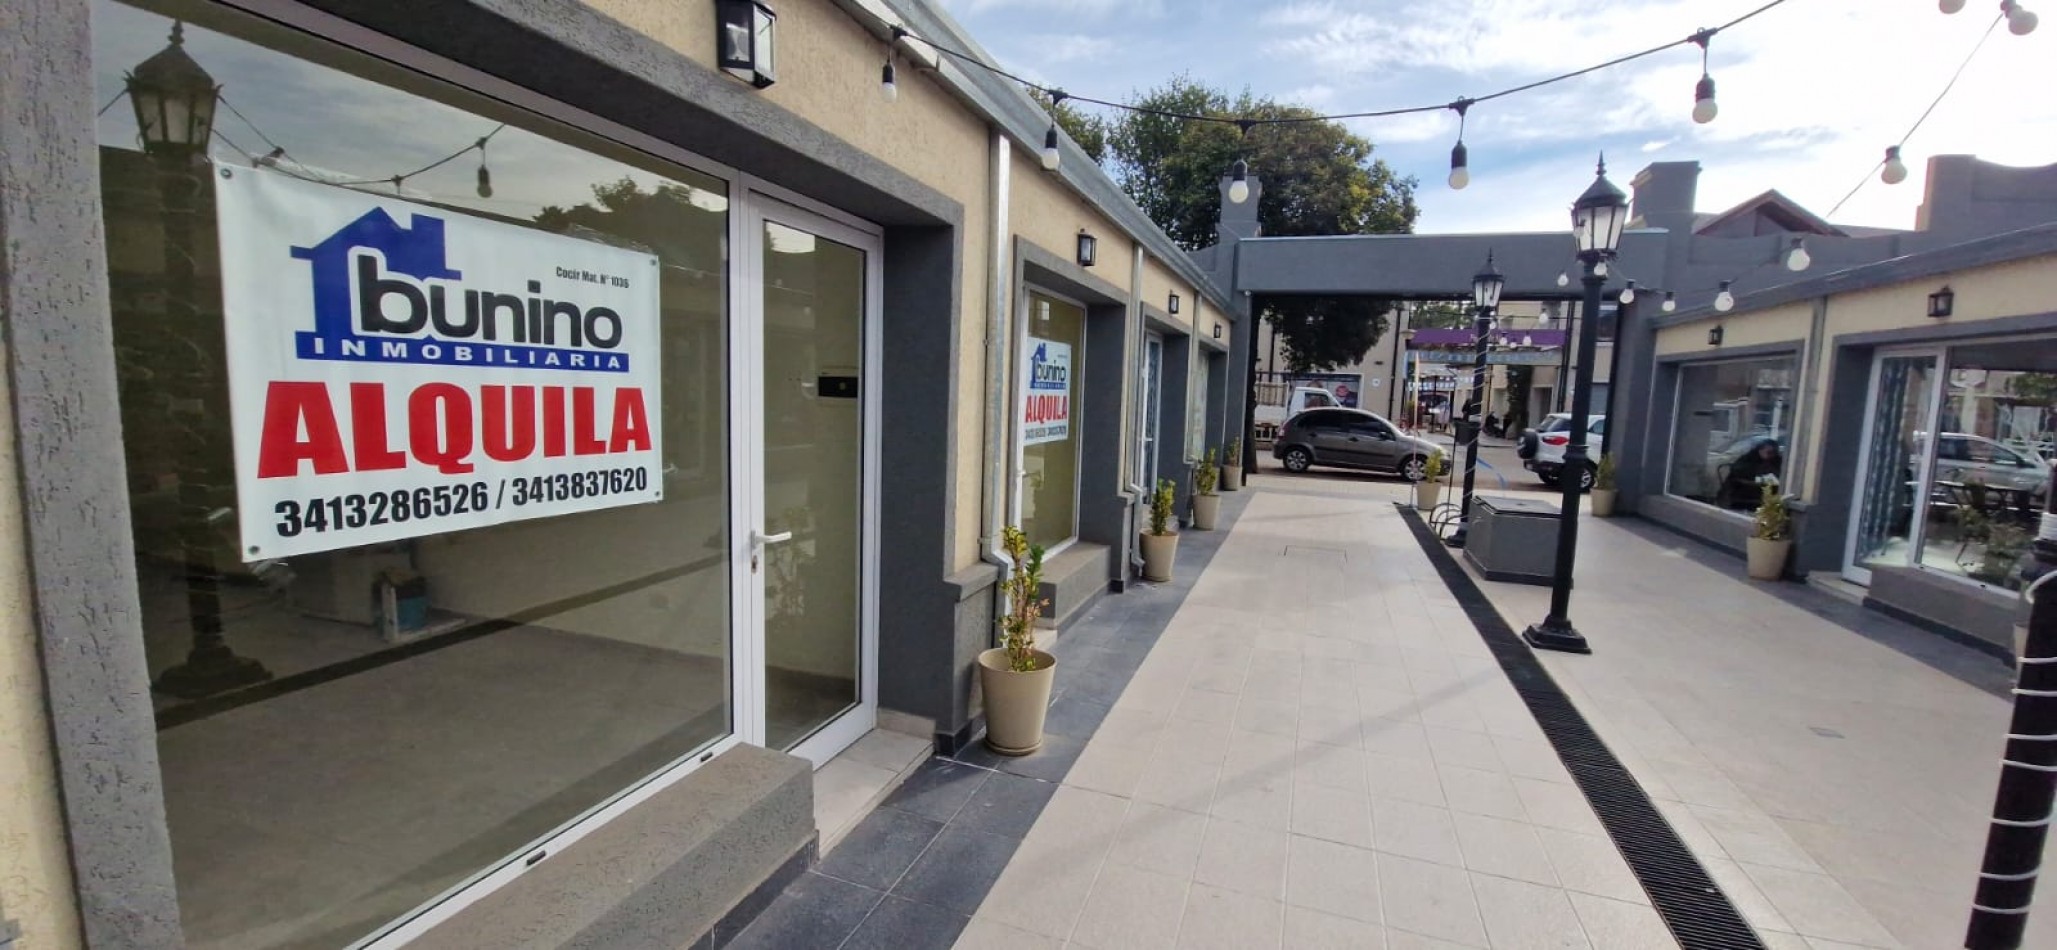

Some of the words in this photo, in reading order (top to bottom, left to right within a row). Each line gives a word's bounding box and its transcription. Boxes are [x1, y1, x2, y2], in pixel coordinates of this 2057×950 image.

[556, 266, 580, 280] Cocir
[582, 270, 599, 284] Mat.
[357, 253, 623, 349] bunino
[313, 337, 621, 369] INMOBILIARIA
[1035, 354, 1067, 382] bunino
[1025, 394, 1068, 424] ALQUILA
[257, 380, 652, 478] ALQUILA
[274, 482, 489, 538] 3413286526
[495, 478, 506, 510] /
[512, 466, 647, 507] 3413837620
